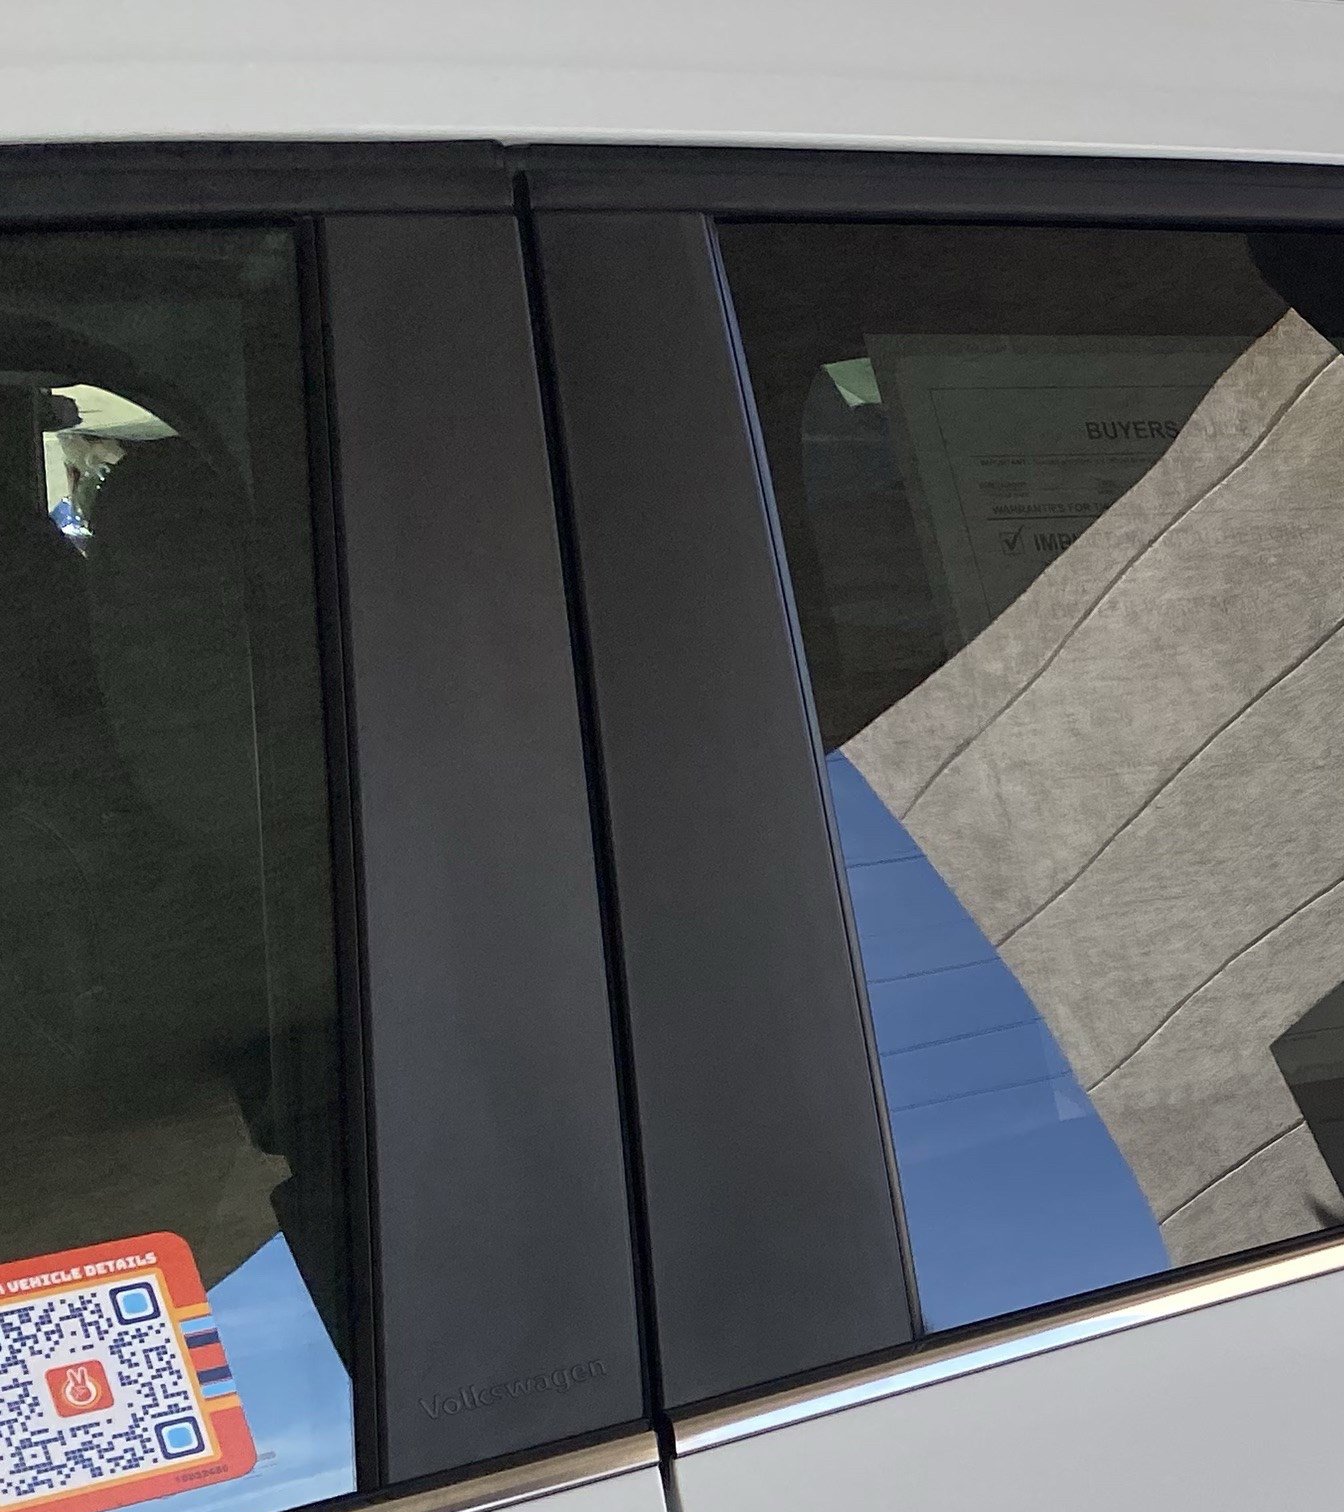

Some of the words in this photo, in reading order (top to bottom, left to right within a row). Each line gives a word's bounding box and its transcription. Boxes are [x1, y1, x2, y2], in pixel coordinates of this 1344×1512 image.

[1085, 421, 1179, 440] BUYERS
[6, 1266, 83, 1293] VEHICLE
[83, 1251, 158, 1277] DETAILS
[418, 1357, 608, 1421] Volkswagen
